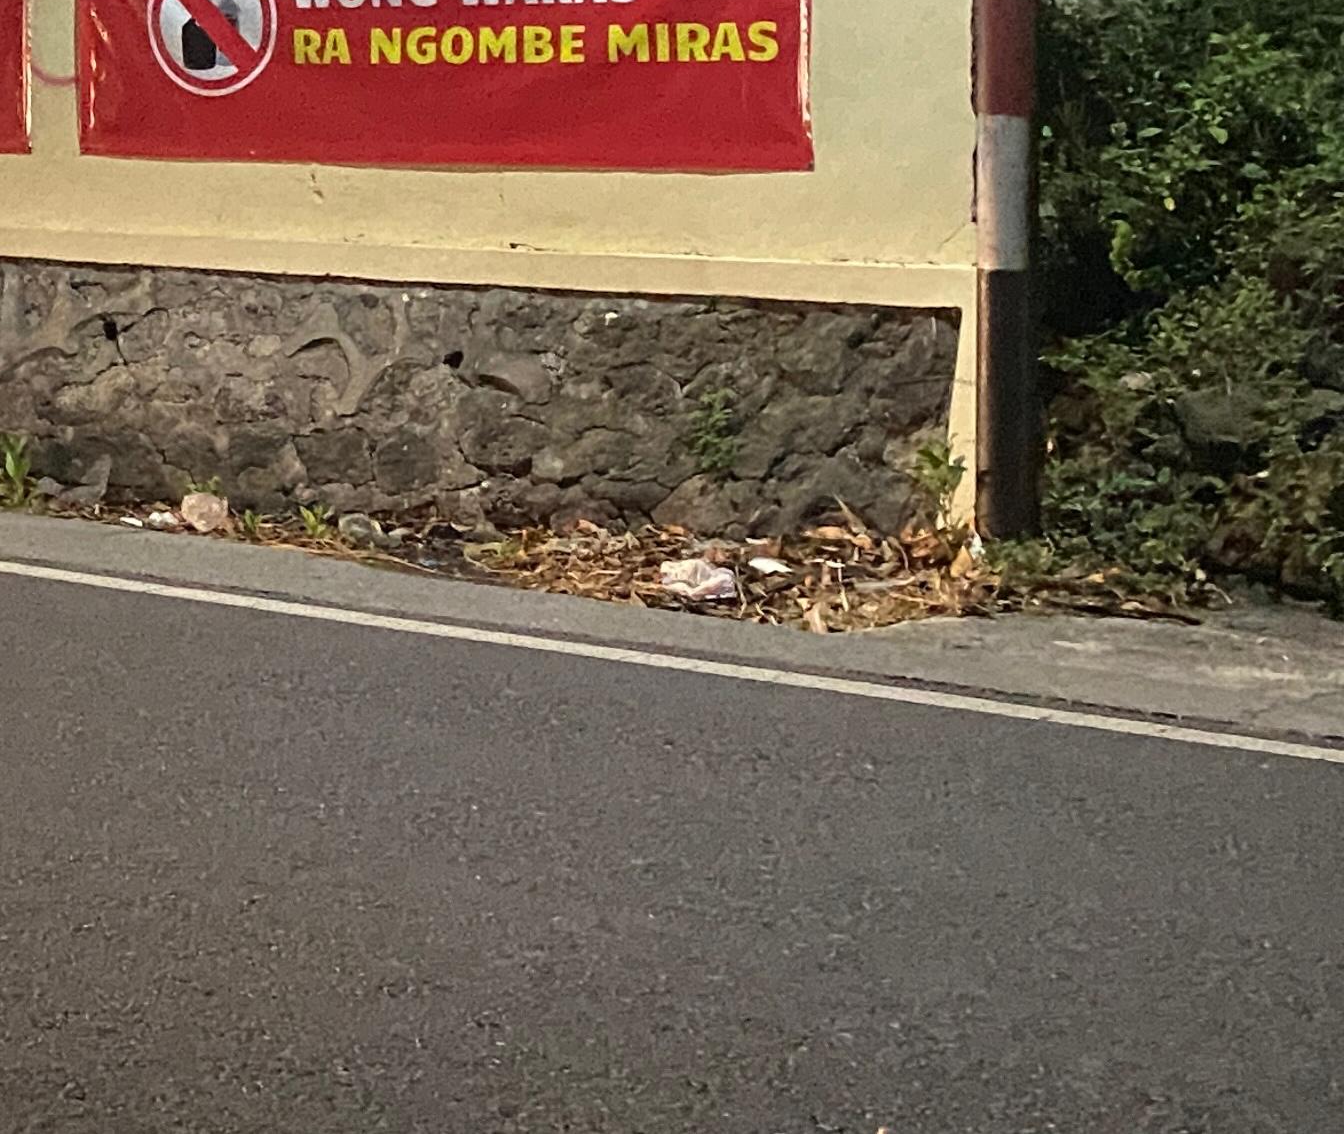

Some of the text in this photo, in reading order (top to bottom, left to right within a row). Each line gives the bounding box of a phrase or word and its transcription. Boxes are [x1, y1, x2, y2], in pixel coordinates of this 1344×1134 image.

[292, 21, 780, 65] RA NGOMBE MIRAS
